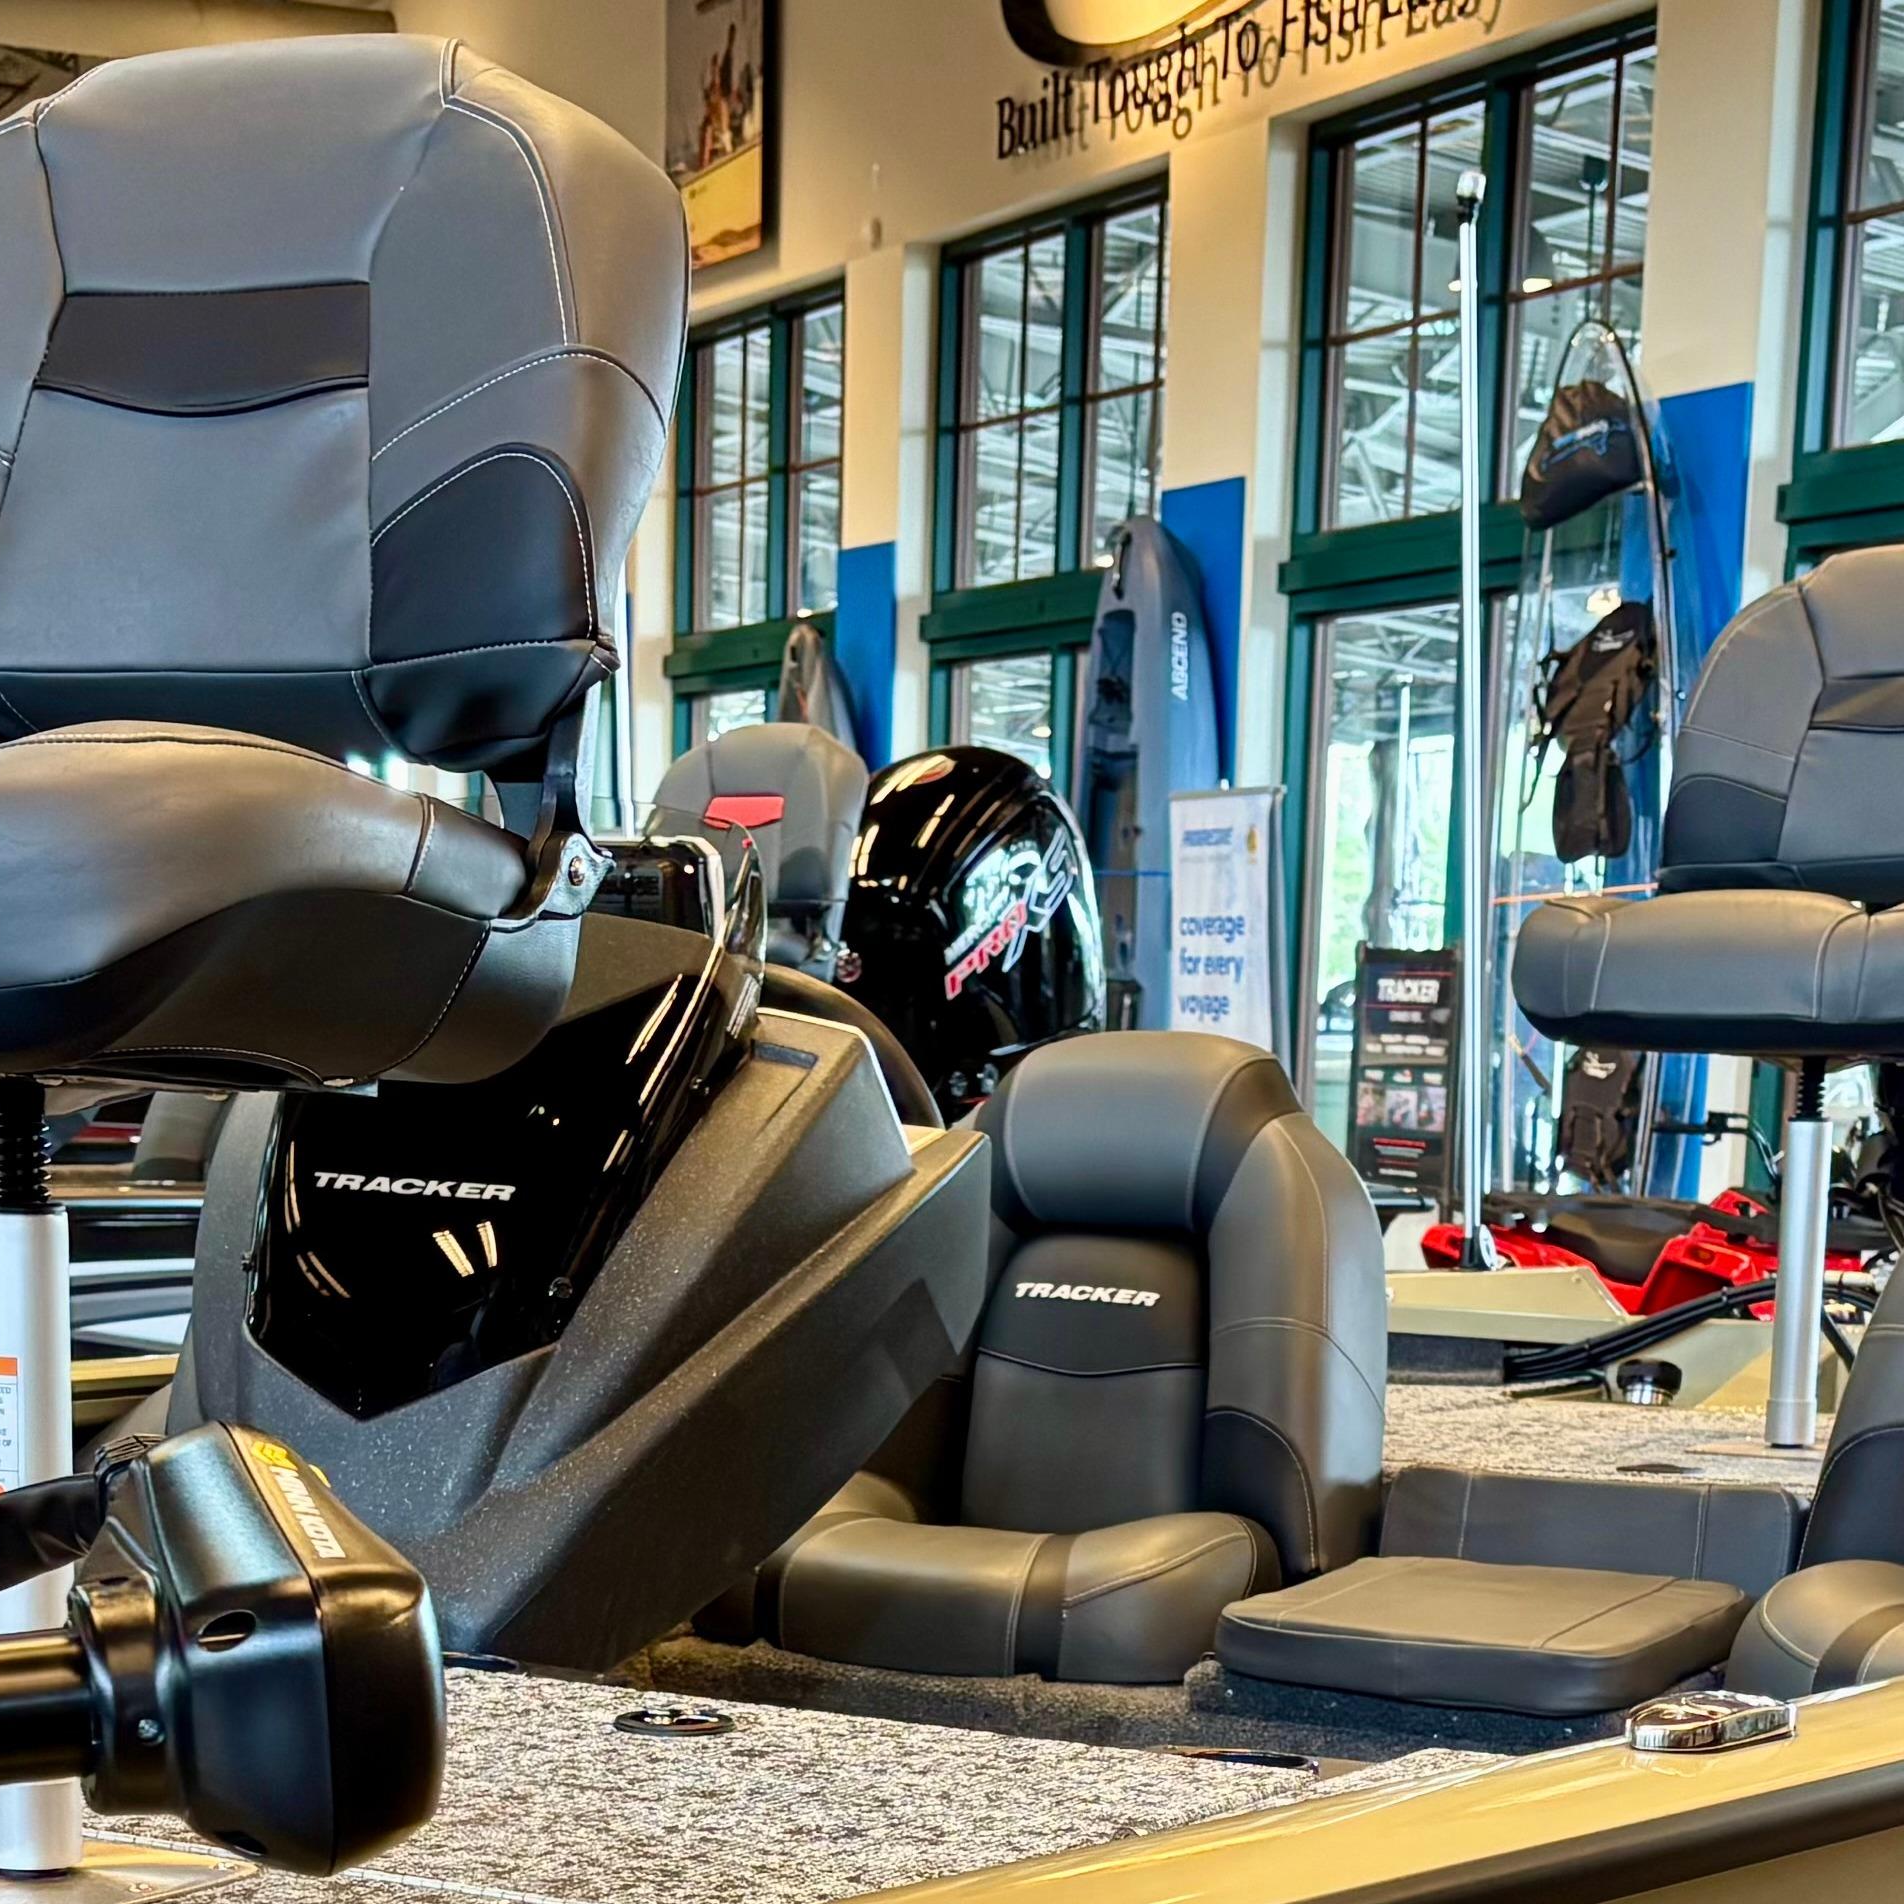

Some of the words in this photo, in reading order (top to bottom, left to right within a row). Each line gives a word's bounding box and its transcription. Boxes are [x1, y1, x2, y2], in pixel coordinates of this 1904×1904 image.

[995, 68, 1075, 160] Built
[1090, 22, 1209, 127] Tough
[1219, 12, 1262, 79] To
[1170, 610, 1189, 701] ASCEND
[1179, 915, 1245, 943] coverage
[943, 900, 1028, 1001] PRO
[1179, 947, 1201, 976] for
[1204, 955, 1245, 984] every
[1377, 978, 1440, 1004] TRACKER
[1178, 994, 1230, 1022] voyage
[313, 1171, 516, 1201] TRACKER
[1015, 1282, 1161, 1307] TRACKER
[269, 1465, 320, 1515] MINN
[296, 1514, 346, 1559] KOTA
